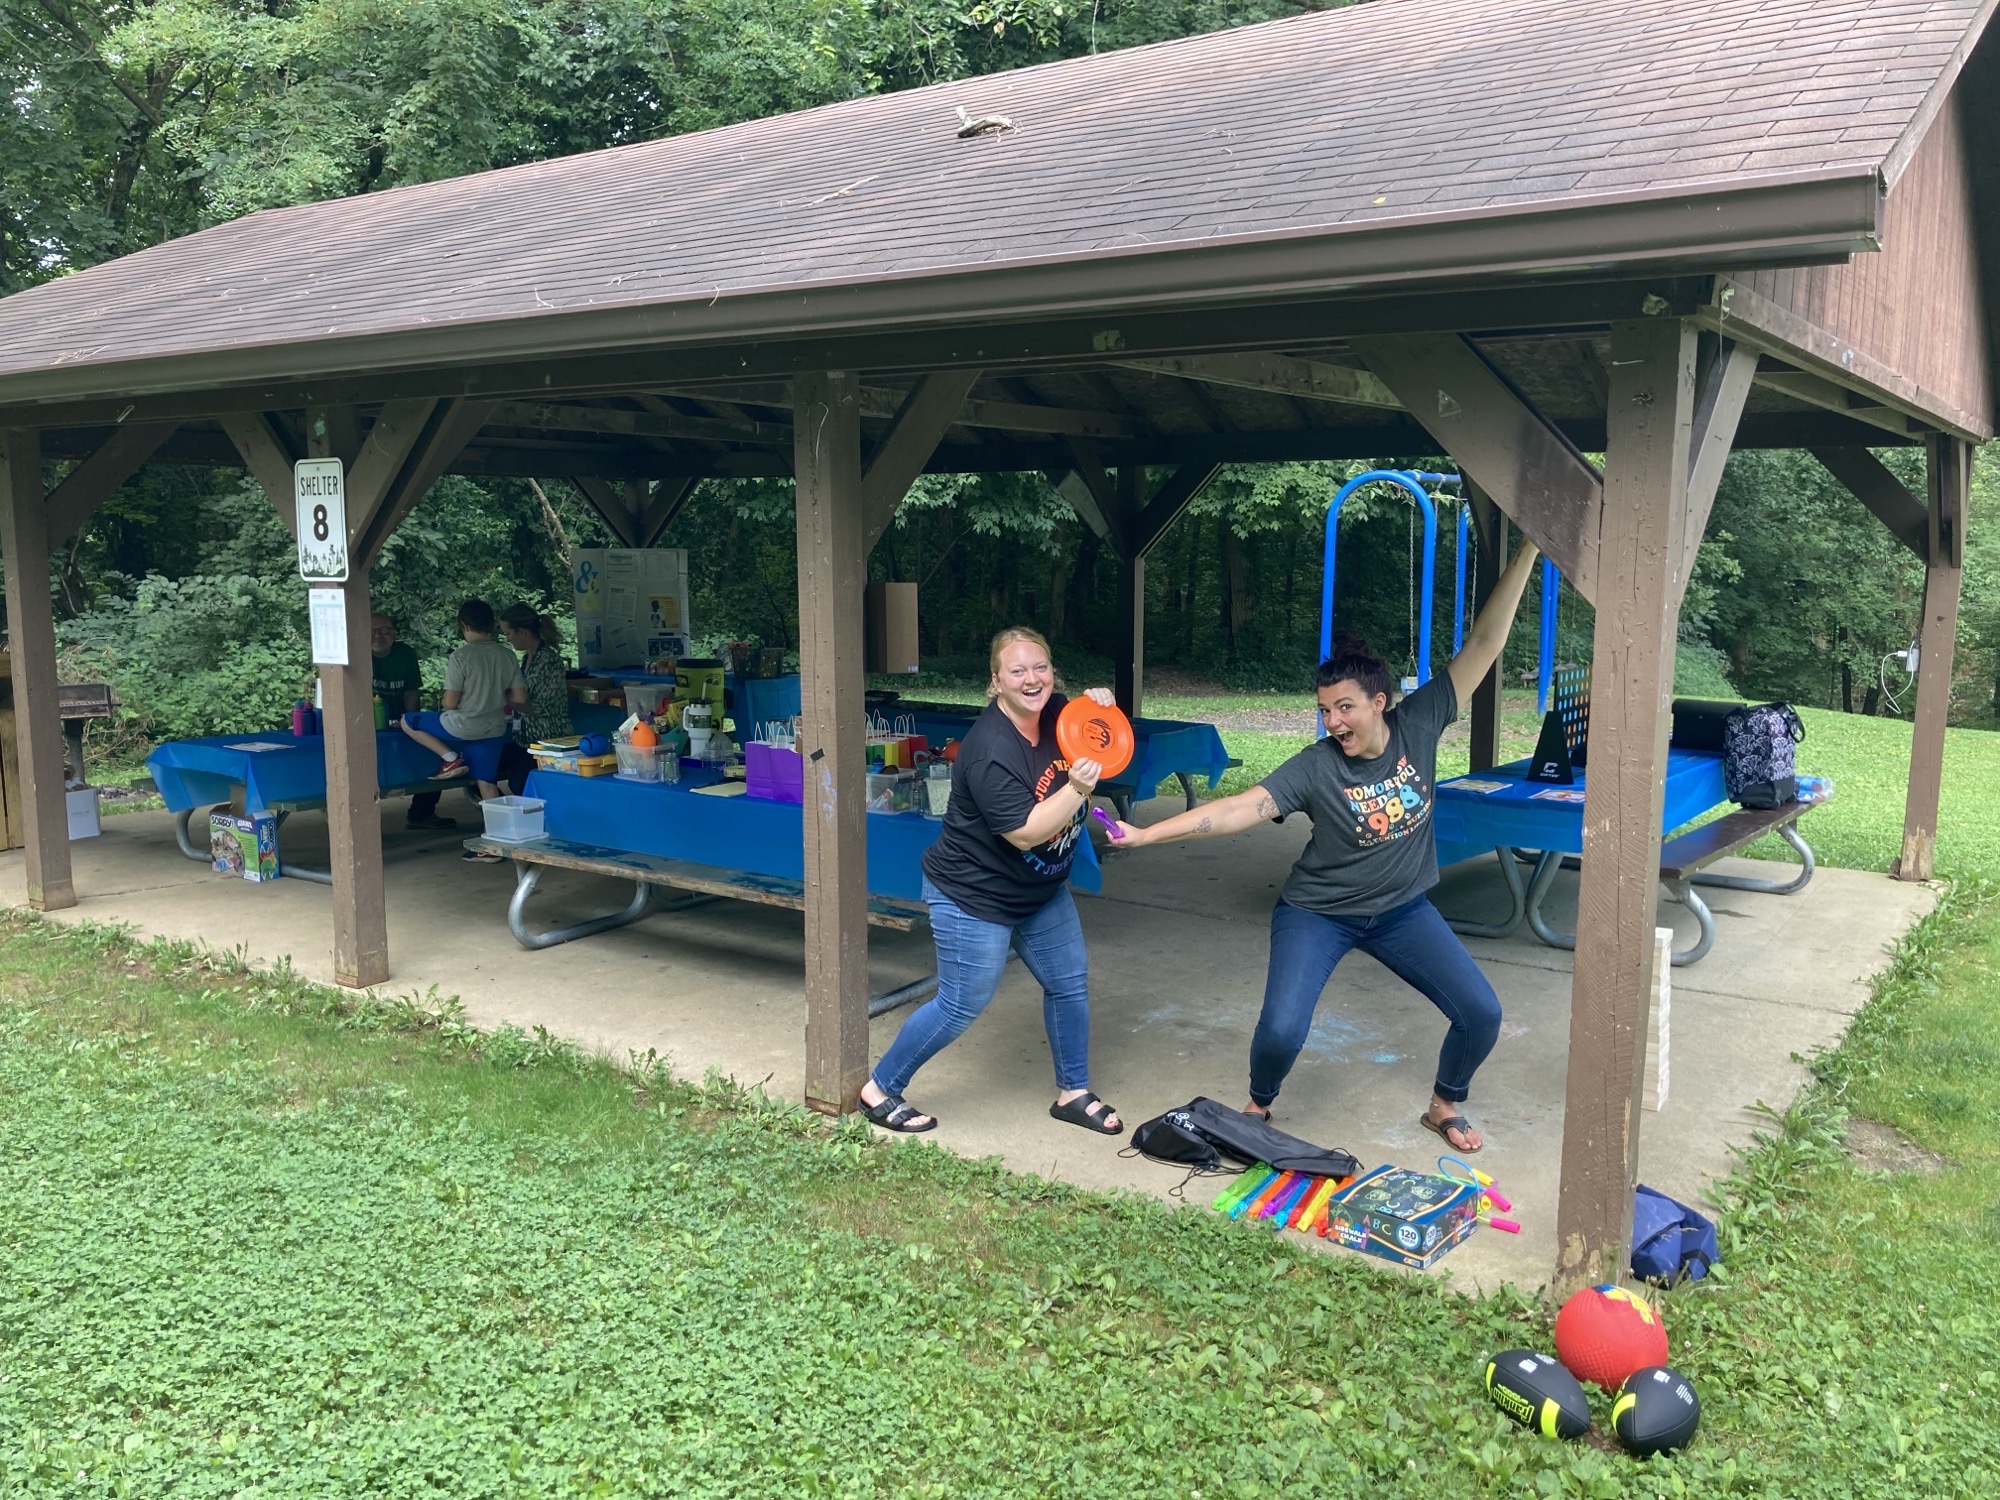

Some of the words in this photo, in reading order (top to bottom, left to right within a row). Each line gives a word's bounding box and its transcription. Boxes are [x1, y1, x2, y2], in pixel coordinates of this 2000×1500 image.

[300, 475, 339, 497] SHELTER
[313, 504, 329, 542] 8
[1035, 764, 1056, 801] JUDG
[1053, 760, 1071, 772] WH
[1367, 784, 1421, 836] 988
[1406, 799, 1432, 826] SUICID
[1334, 1224, 1368, 1239] SIDEWALK
[1339, 1232, 1363, 1244] CHALK
[1400, 1228, 1417, 1241] 120
